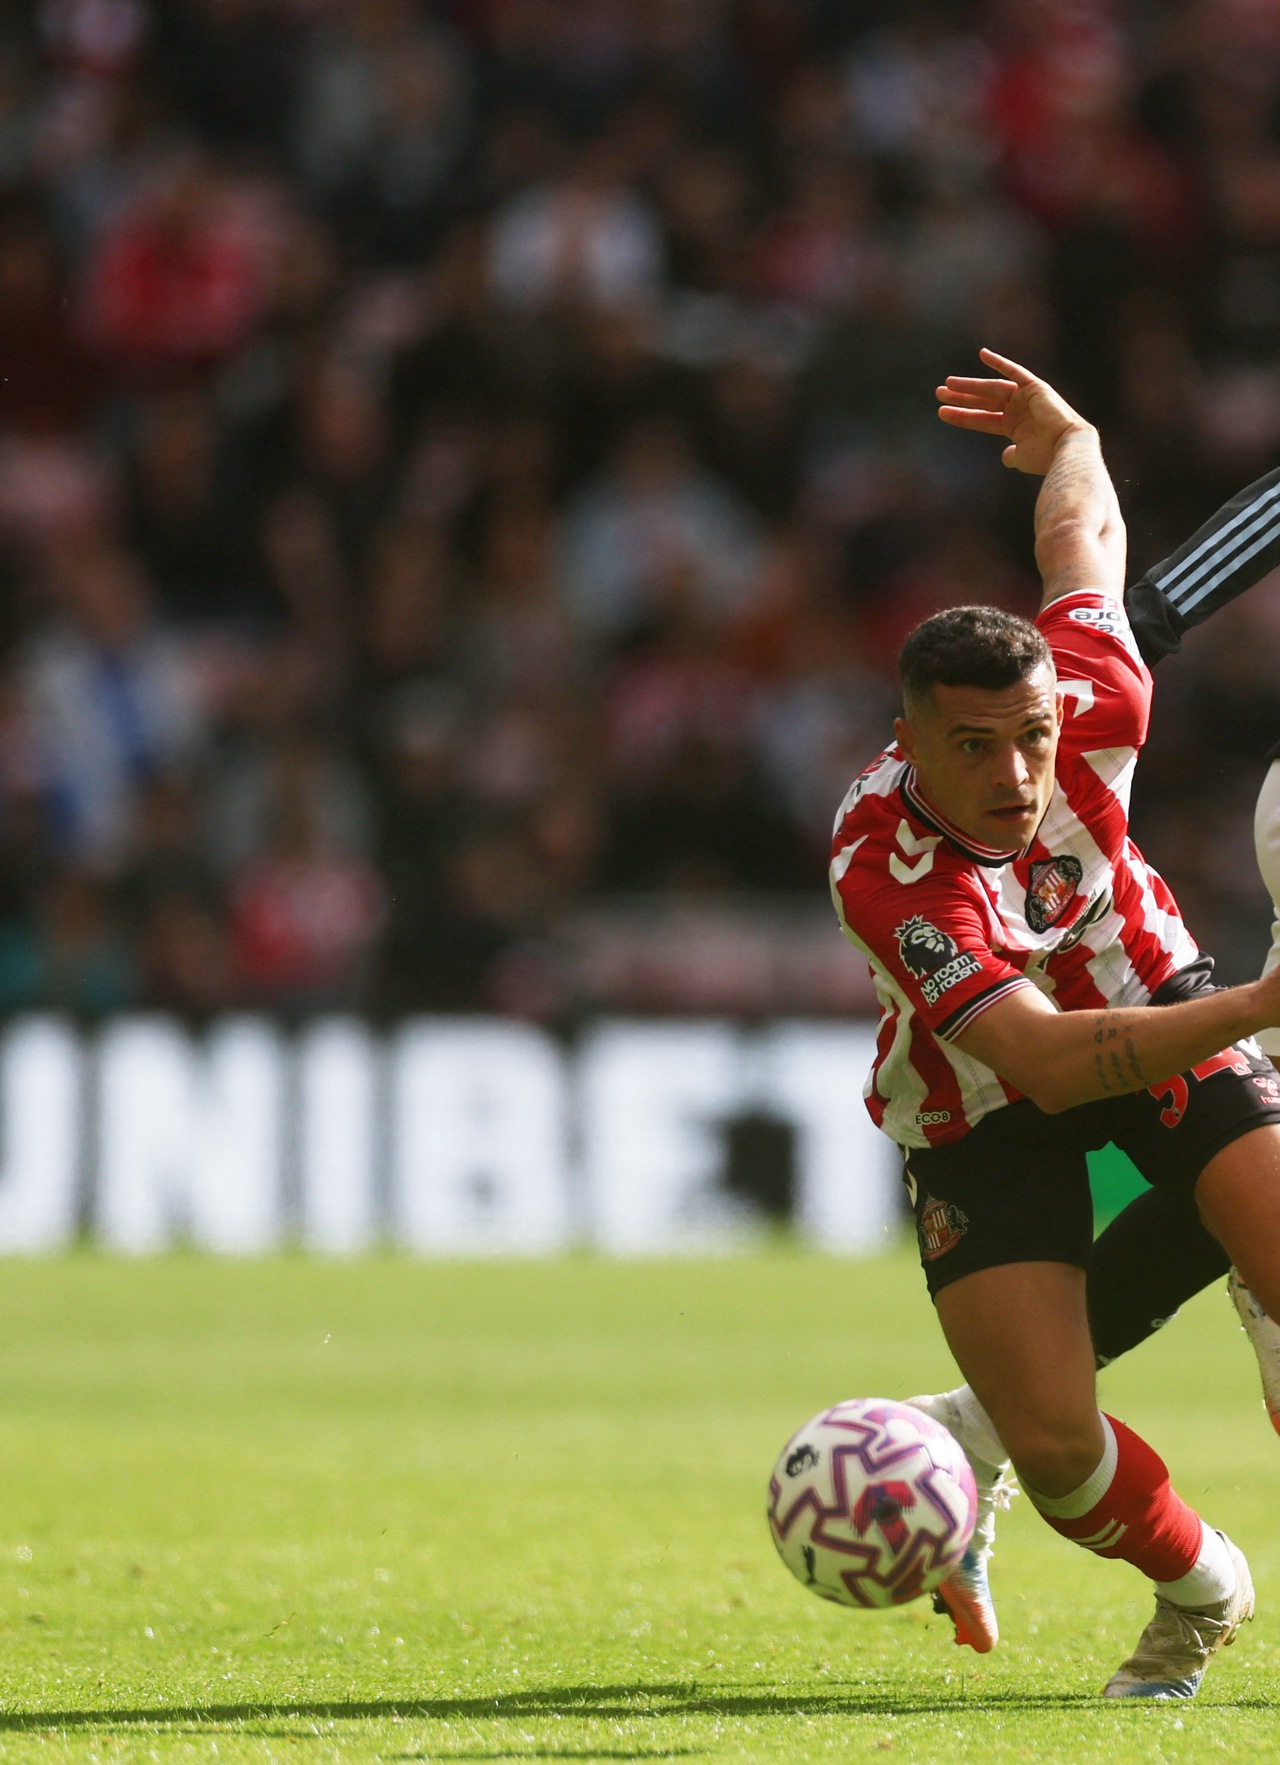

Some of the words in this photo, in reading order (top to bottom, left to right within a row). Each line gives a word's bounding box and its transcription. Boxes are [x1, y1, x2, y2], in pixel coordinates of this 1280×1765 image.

[920, 979, 935, 993] No
[933, 955, 971, 983] room
[924, 987, 940, 1008] for
[939, 961, 983, 993] racism
